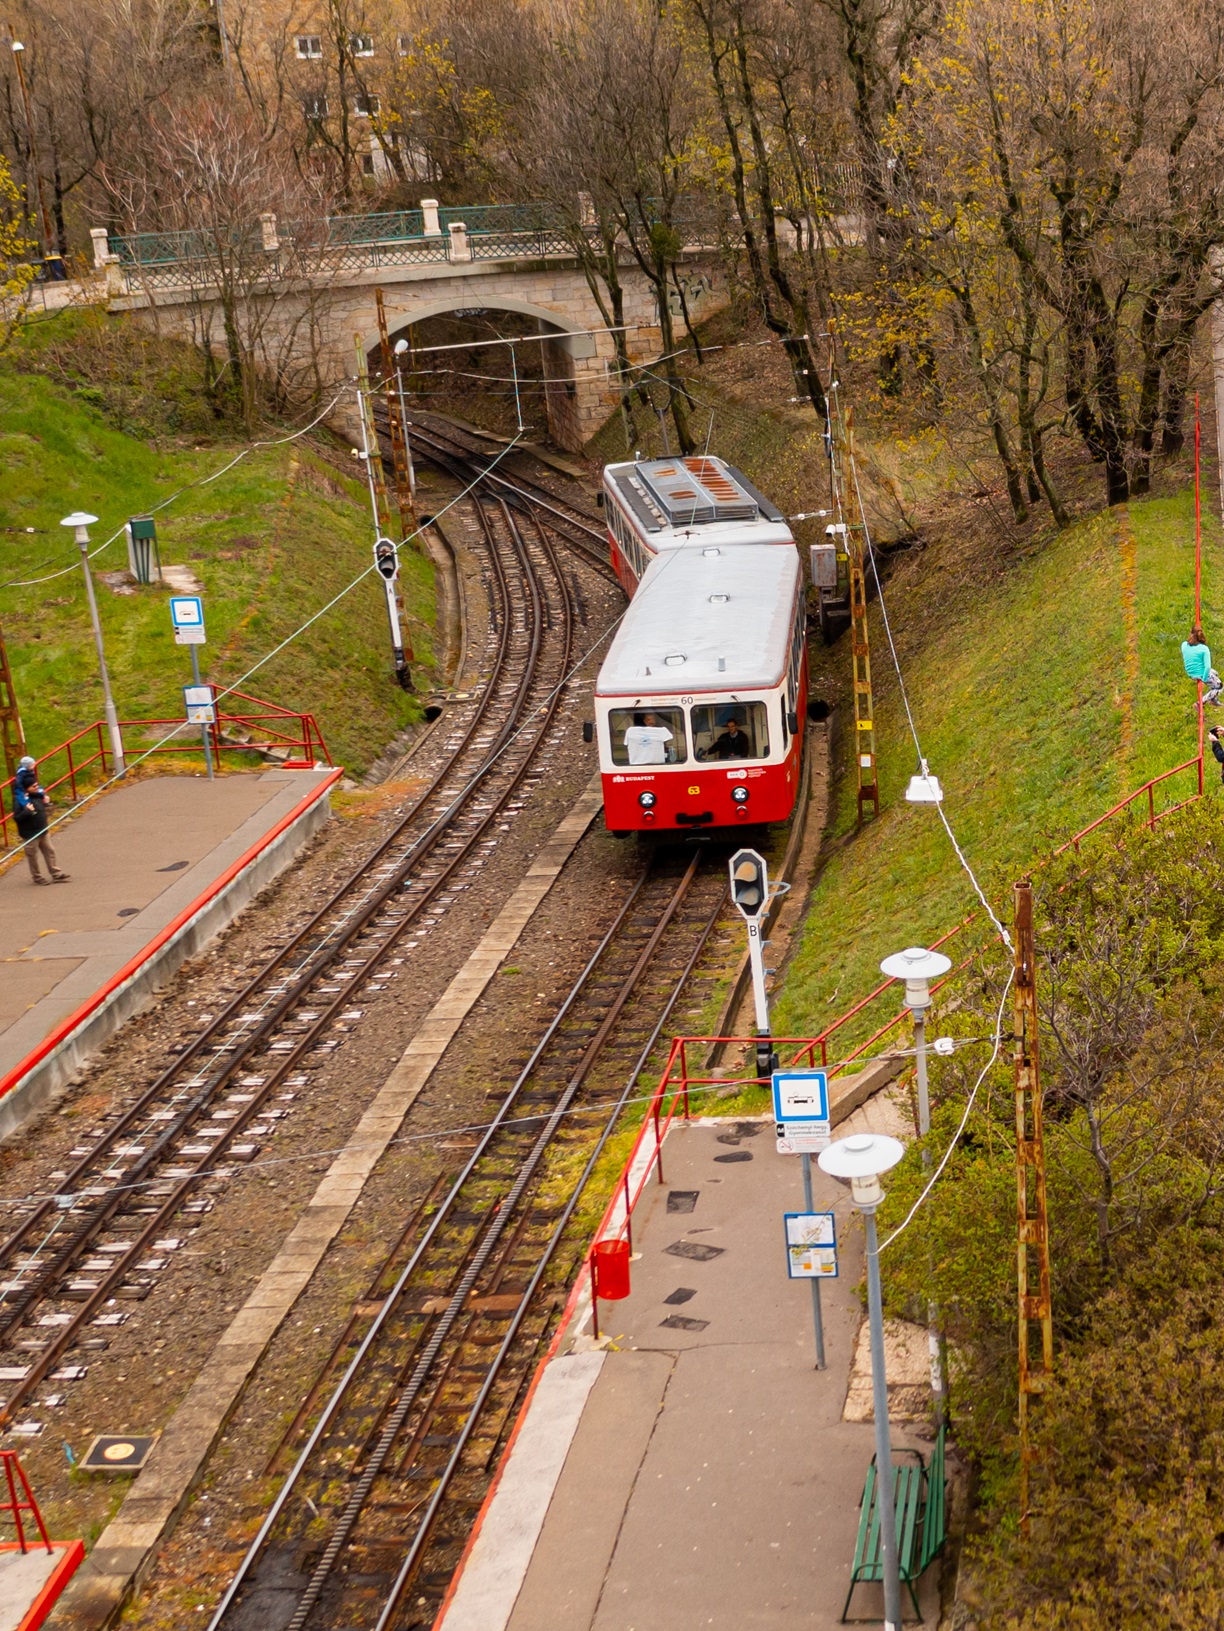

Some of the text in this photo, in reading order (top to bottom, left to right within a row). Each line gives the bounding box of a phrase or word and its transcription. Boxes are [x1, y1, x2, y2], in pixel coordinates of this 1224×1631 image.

[681, 696, 694, 705] 60
[687, 785, 701, 796] 63
[749, 925, 757, 937] B
